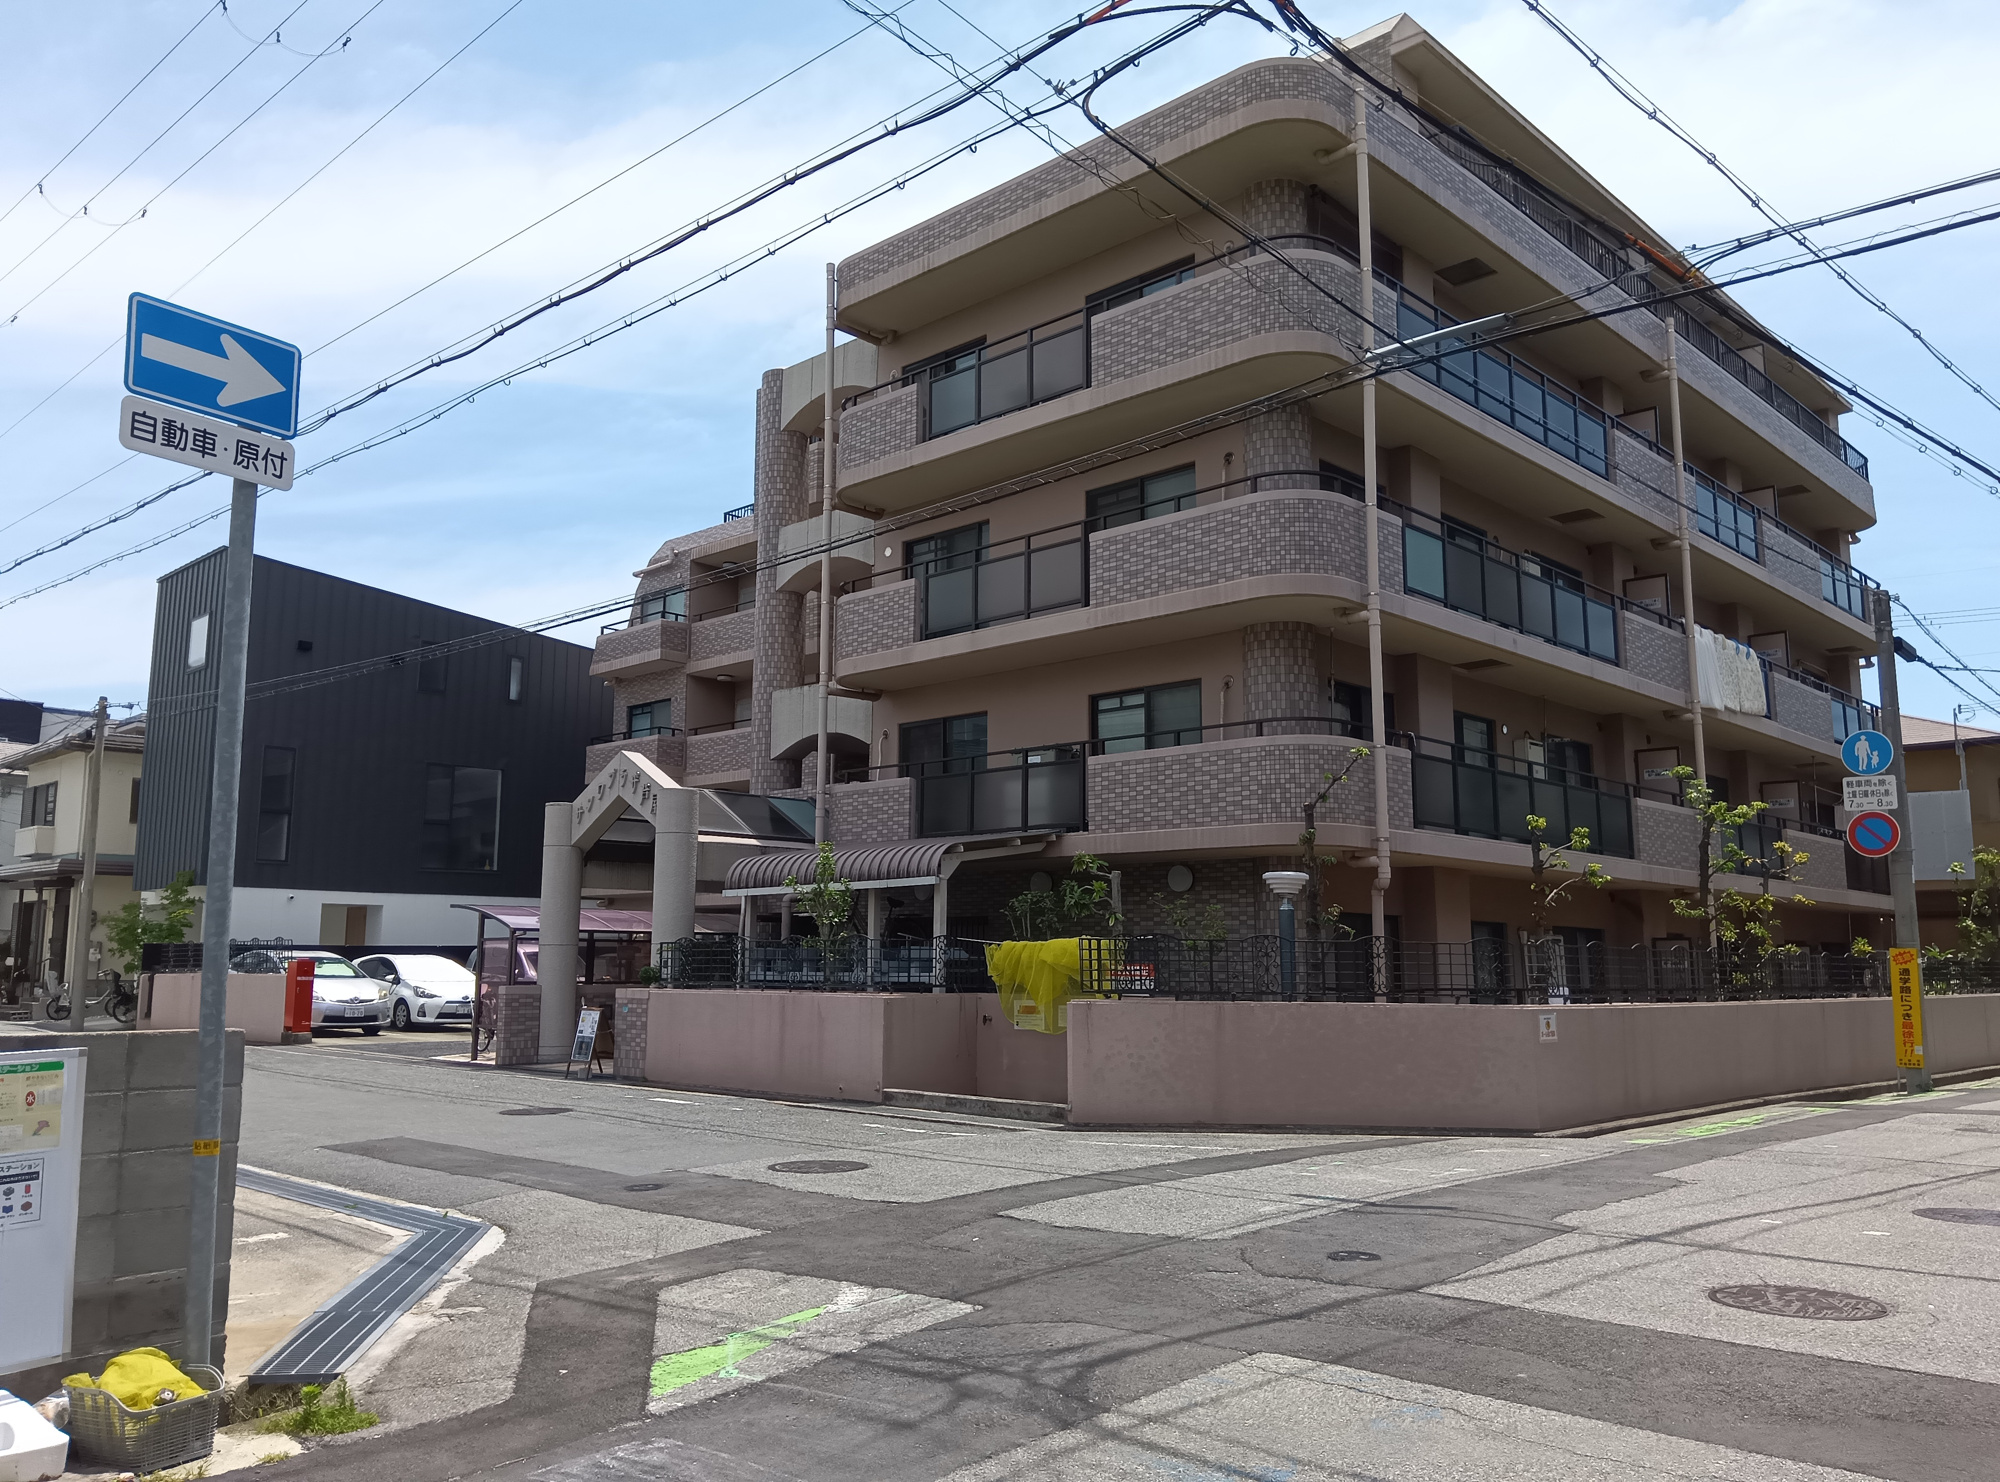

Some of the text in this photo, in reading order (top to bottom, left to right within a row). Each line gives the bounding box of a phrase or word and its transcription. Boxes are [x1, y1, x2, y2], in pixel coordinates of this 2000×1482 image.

[130, 411, 288, 479] 自動車・原付
[1846, 778, 1892, 788] 軽車両を除く
[0, 1064, 40, 1074] テーション
[26, 1094, 35, 1104] 水
